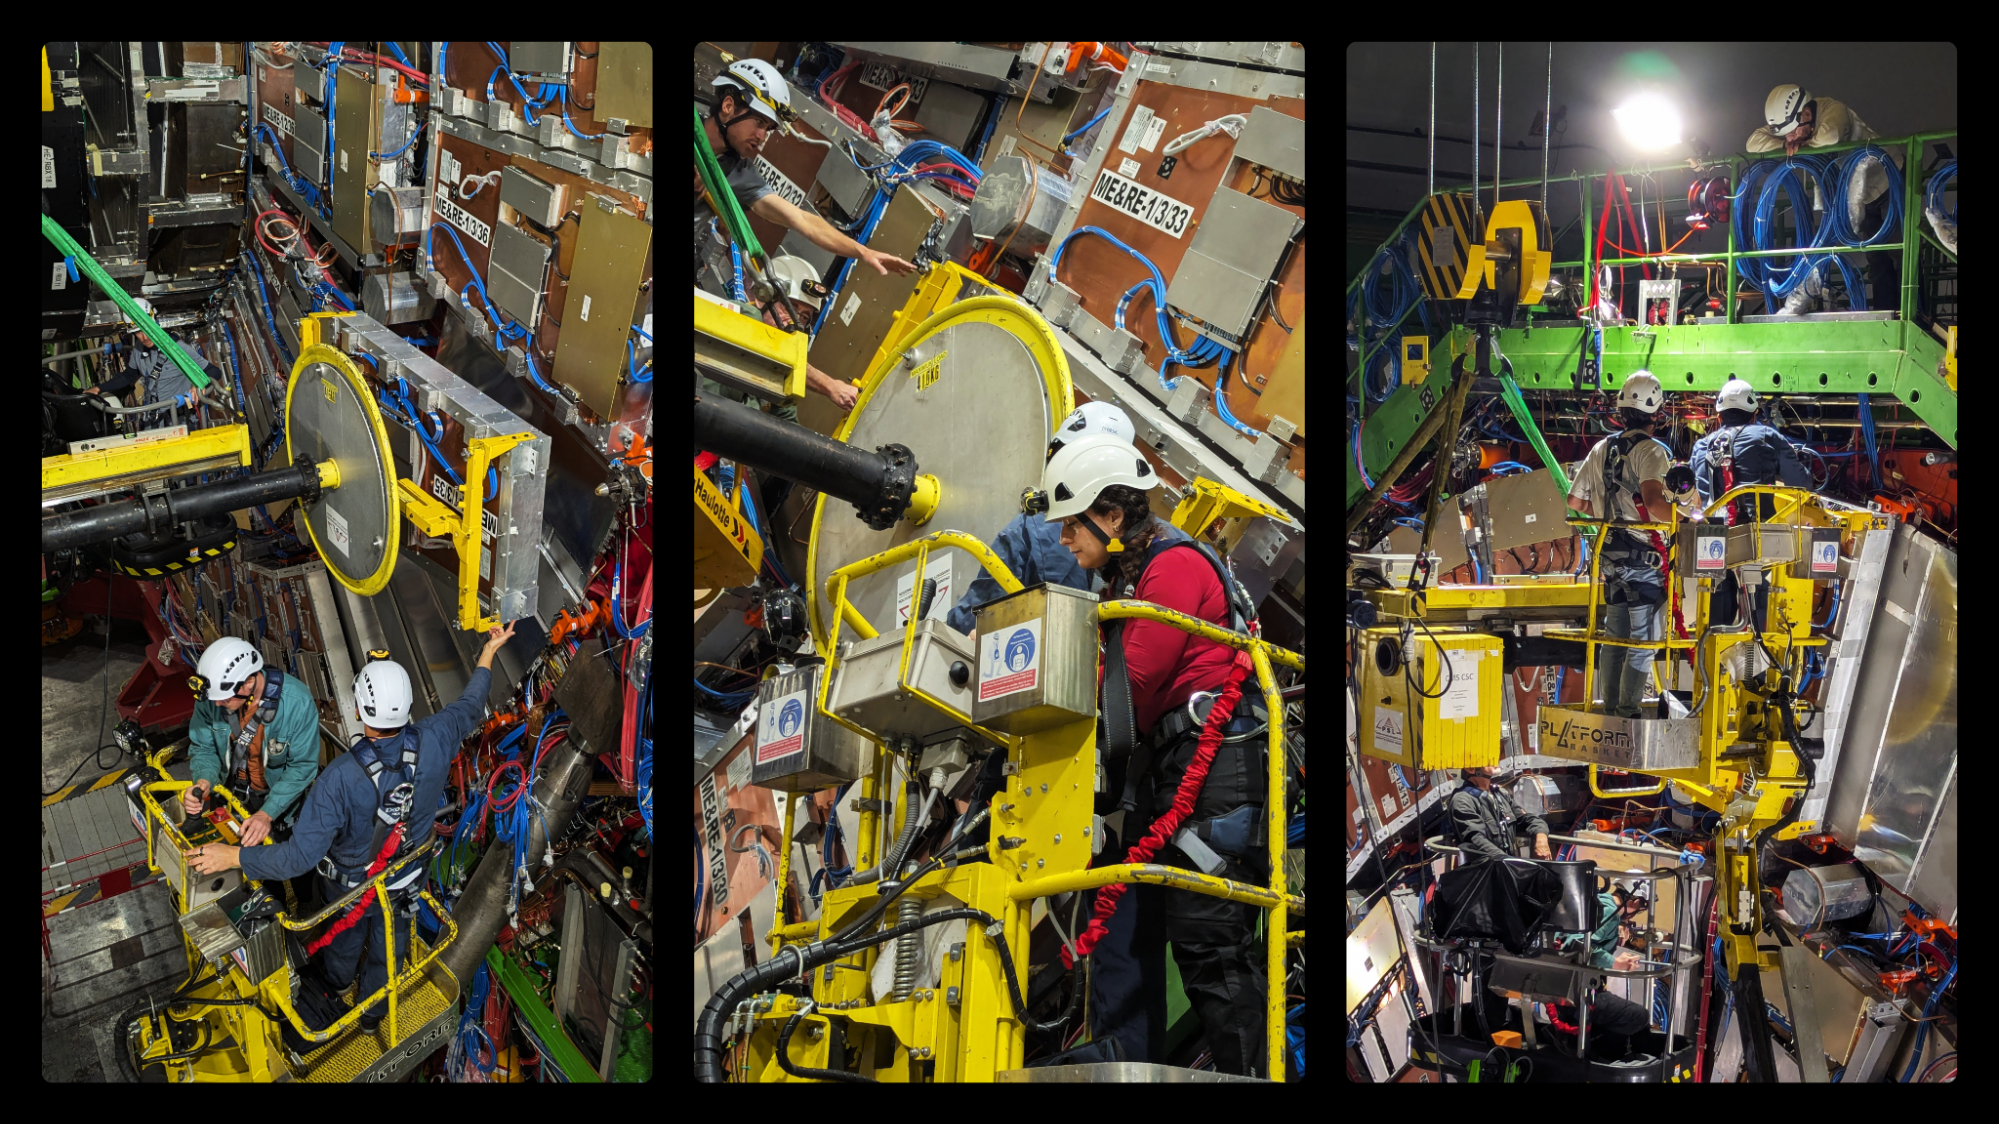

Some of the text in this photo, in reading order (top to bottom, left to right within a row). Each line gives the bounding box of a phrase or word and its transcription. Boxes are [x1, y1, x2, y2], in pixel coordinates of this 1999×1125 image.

[435, 195, 489, 244] ME&RE-1/3/36
[1093, 172, 1189, 234] ME&RE-1/3/33
[695, 477, 730, 528] Haulotte
[1461, 672, 1474, 681] CSC
[1381, 725, 1396, 735] PSL
[1540, 718, 1632, 749] PLATFORM
[1569, 743, 1631, 759] BASKET
[701, 775, 728, 905] ME&RE-1/3/30
